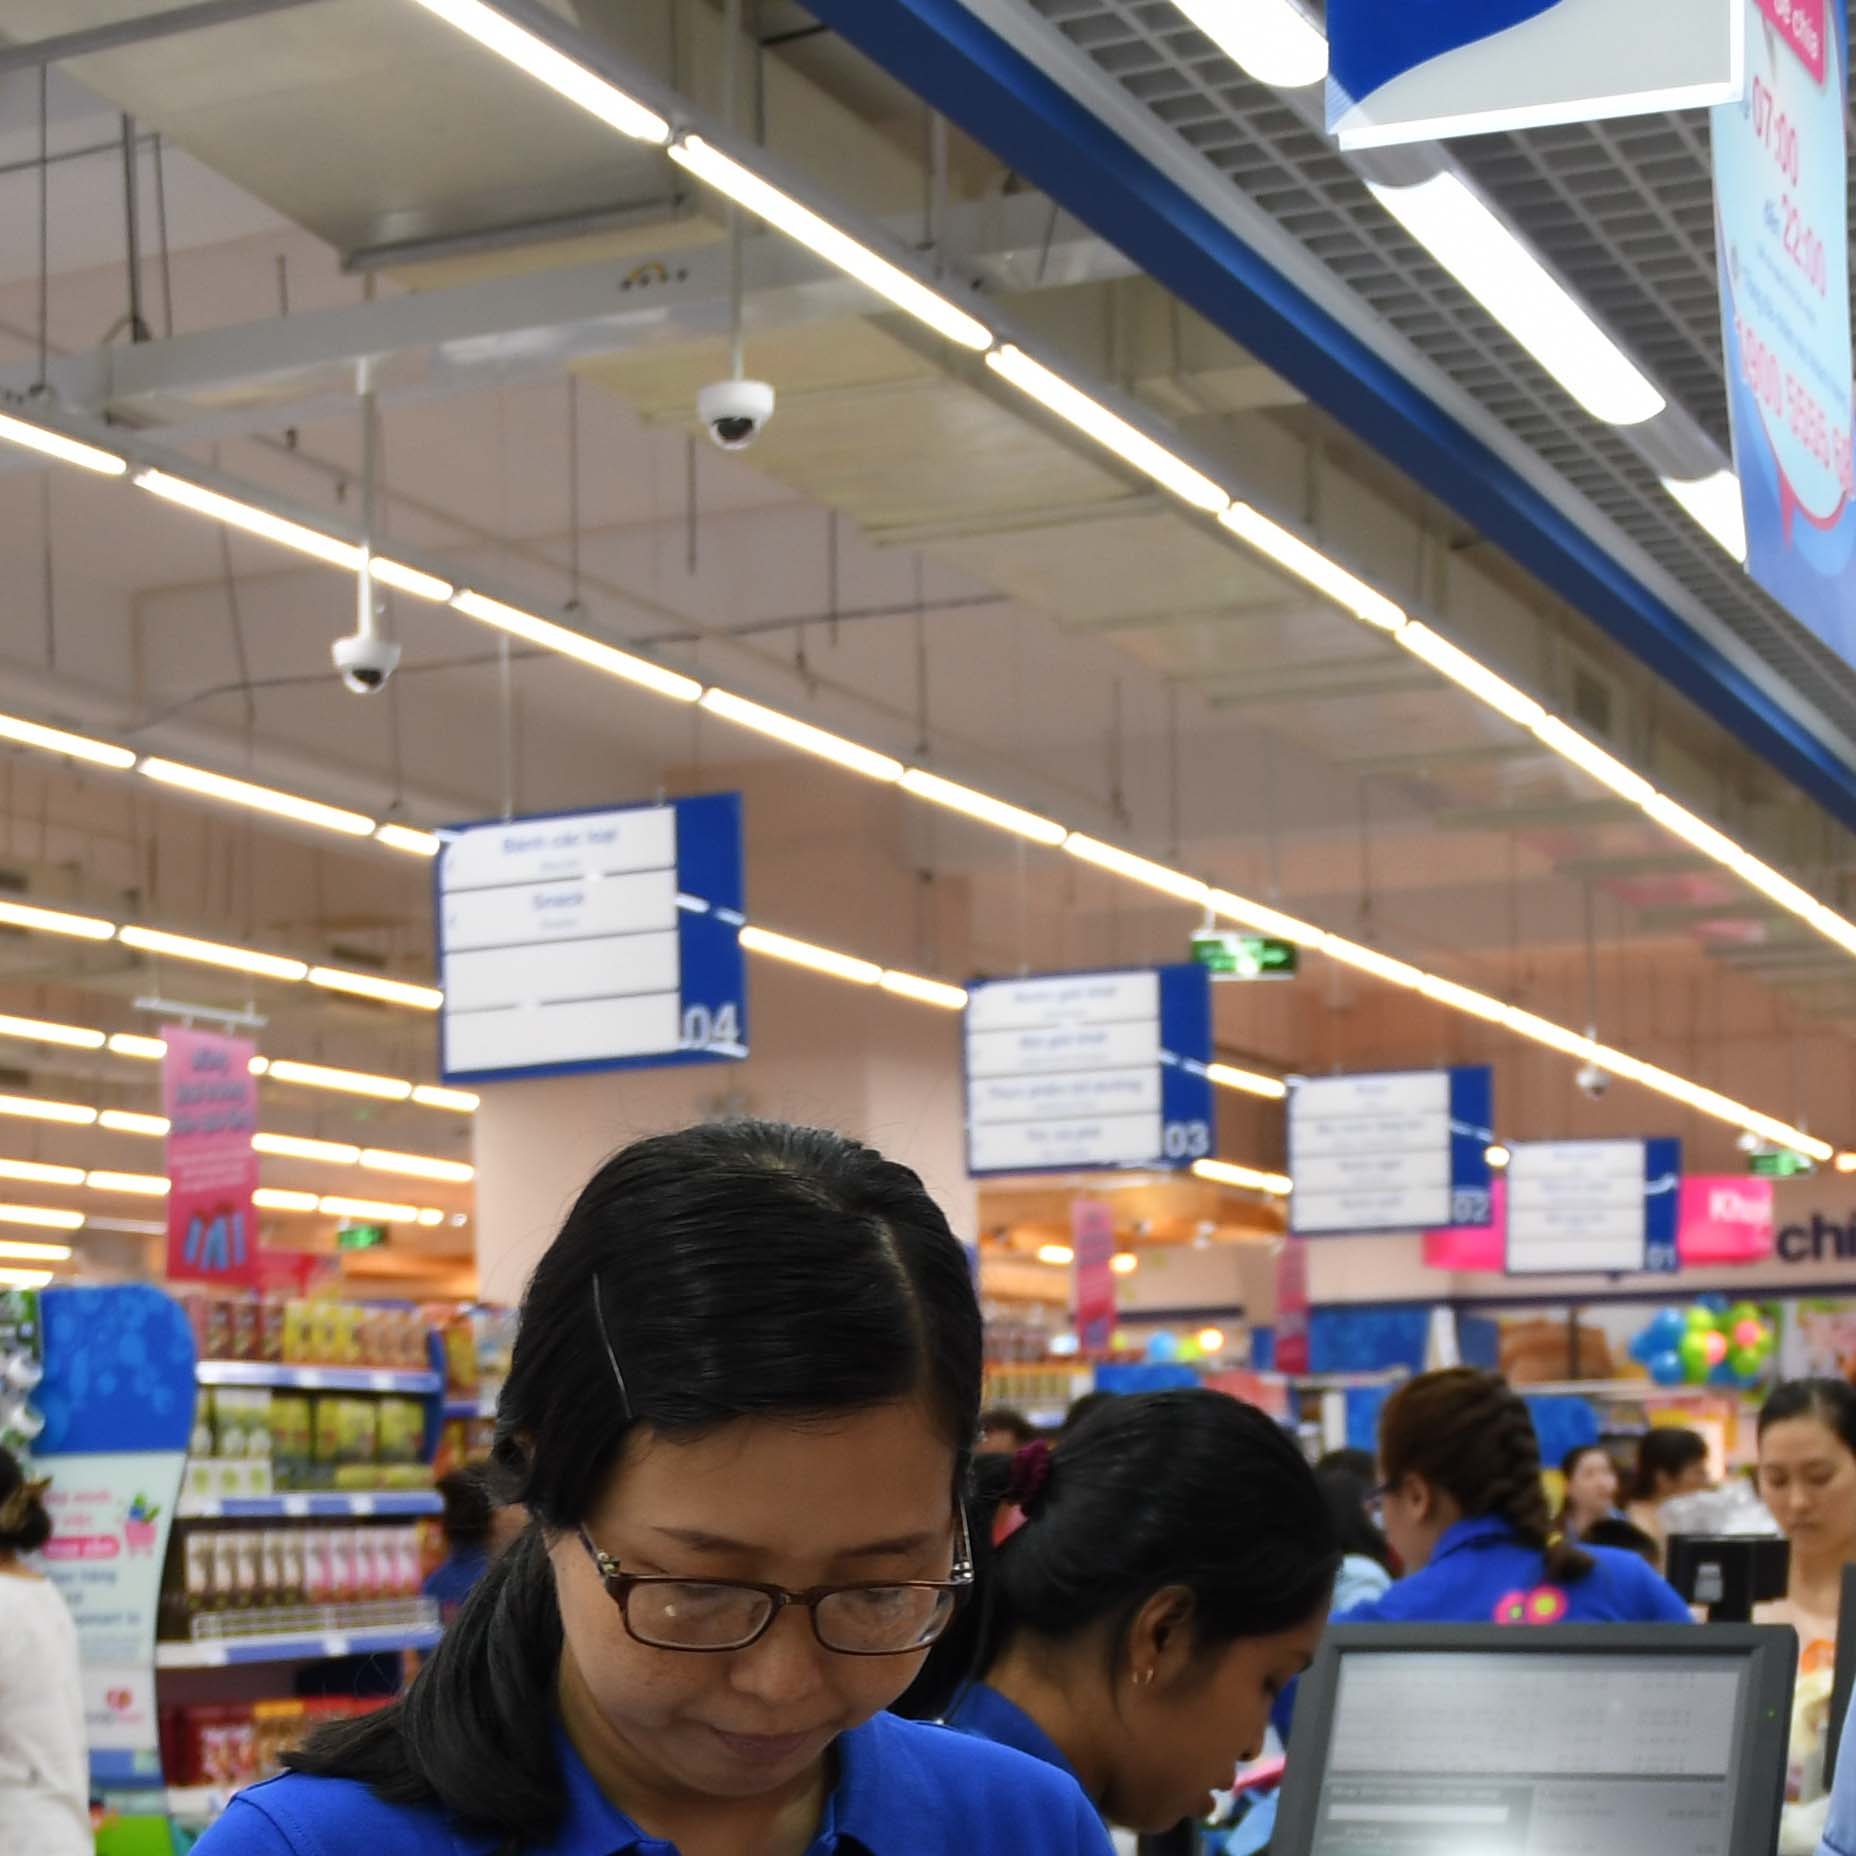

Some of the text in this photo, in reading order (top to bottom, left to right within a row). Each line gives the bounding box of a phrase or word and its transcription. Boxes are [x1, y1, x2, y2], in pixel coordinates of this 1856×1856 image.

[683, 1003, 741, 1047] 04
[1164, 1122, 1210, 1159] 03
[1453, 1192, 1492, 1225] 02
